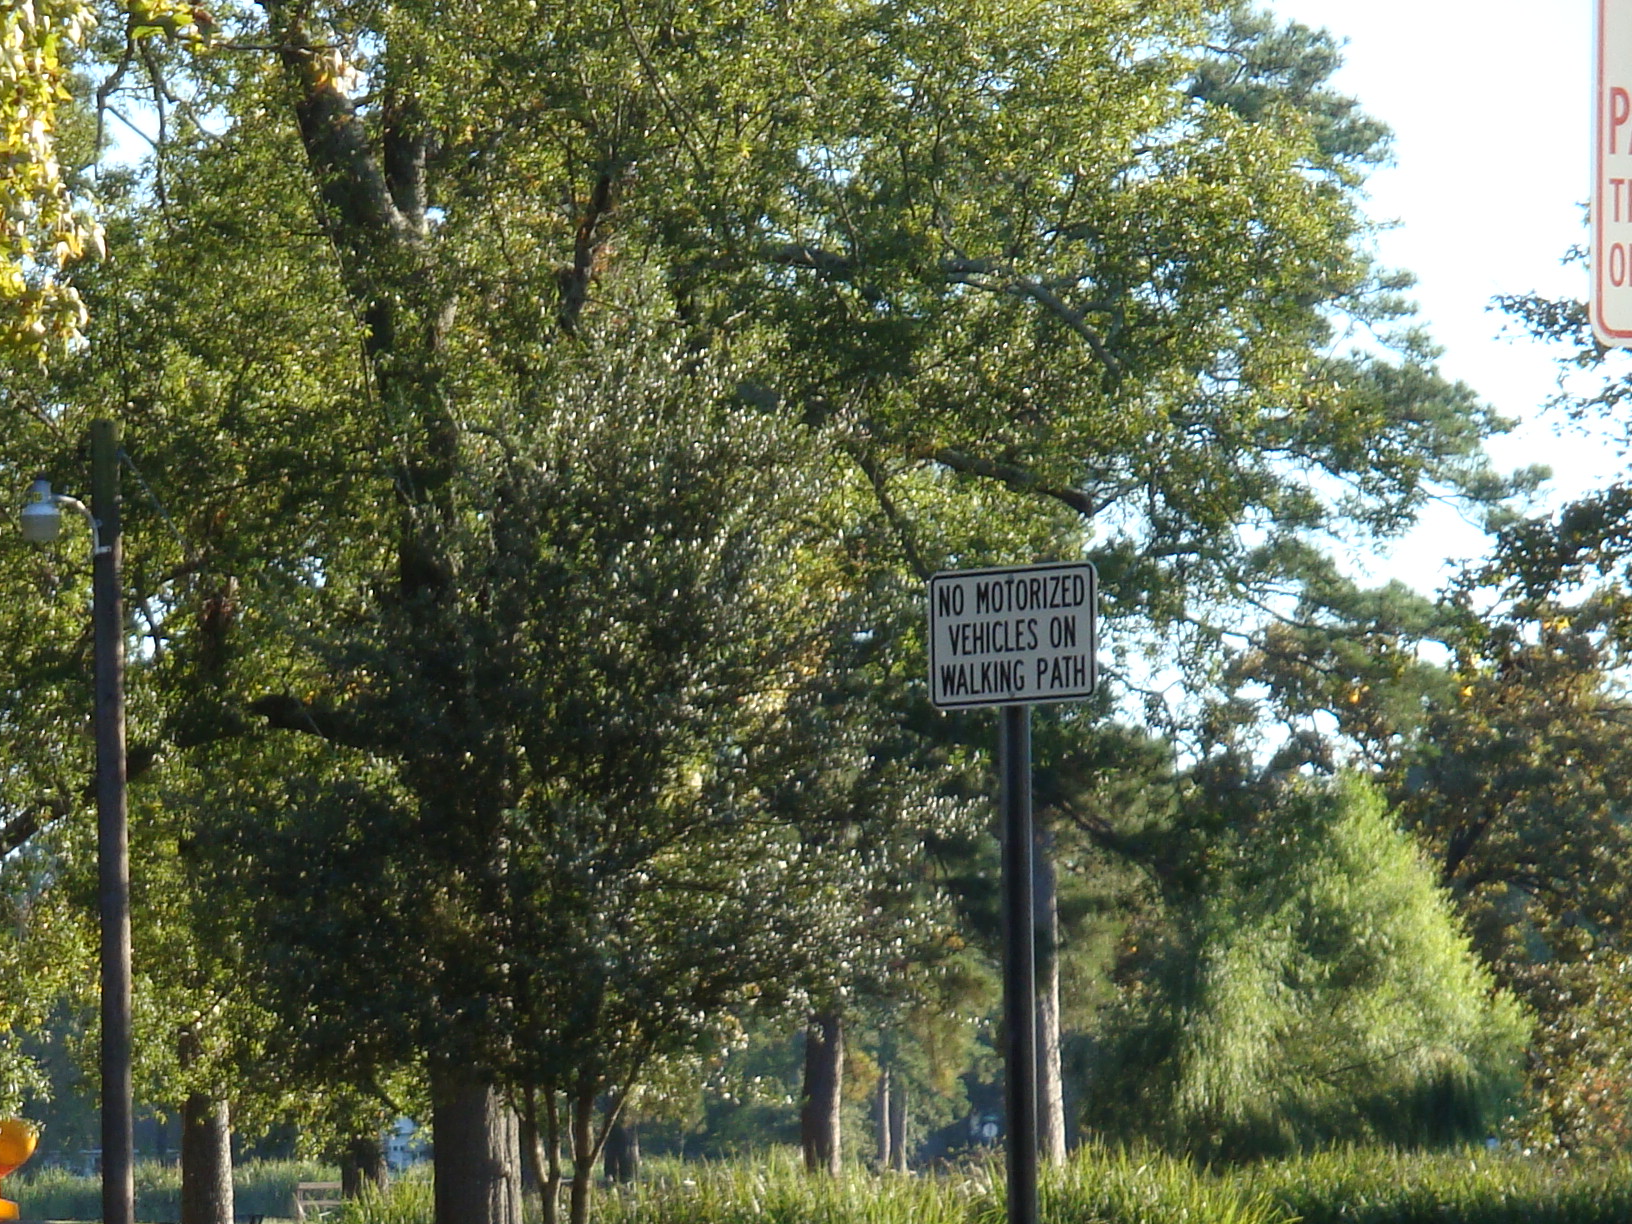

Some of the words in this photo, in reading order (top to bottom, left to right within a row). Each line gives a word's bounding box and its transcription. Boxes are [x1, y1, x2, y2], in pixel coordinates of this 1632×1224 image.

[1608, 86, 1632, 155] P
[939, 584, 965, 618] NO
[976, 574, 1085, 614] MOTORIZED
[949, 619, 1039, 656] VEHICLES
[1050, 615, 1076, 649] ON
[941, 660, 1025, 697] WALKING
[1037, 655, 1086, 690] PATH
